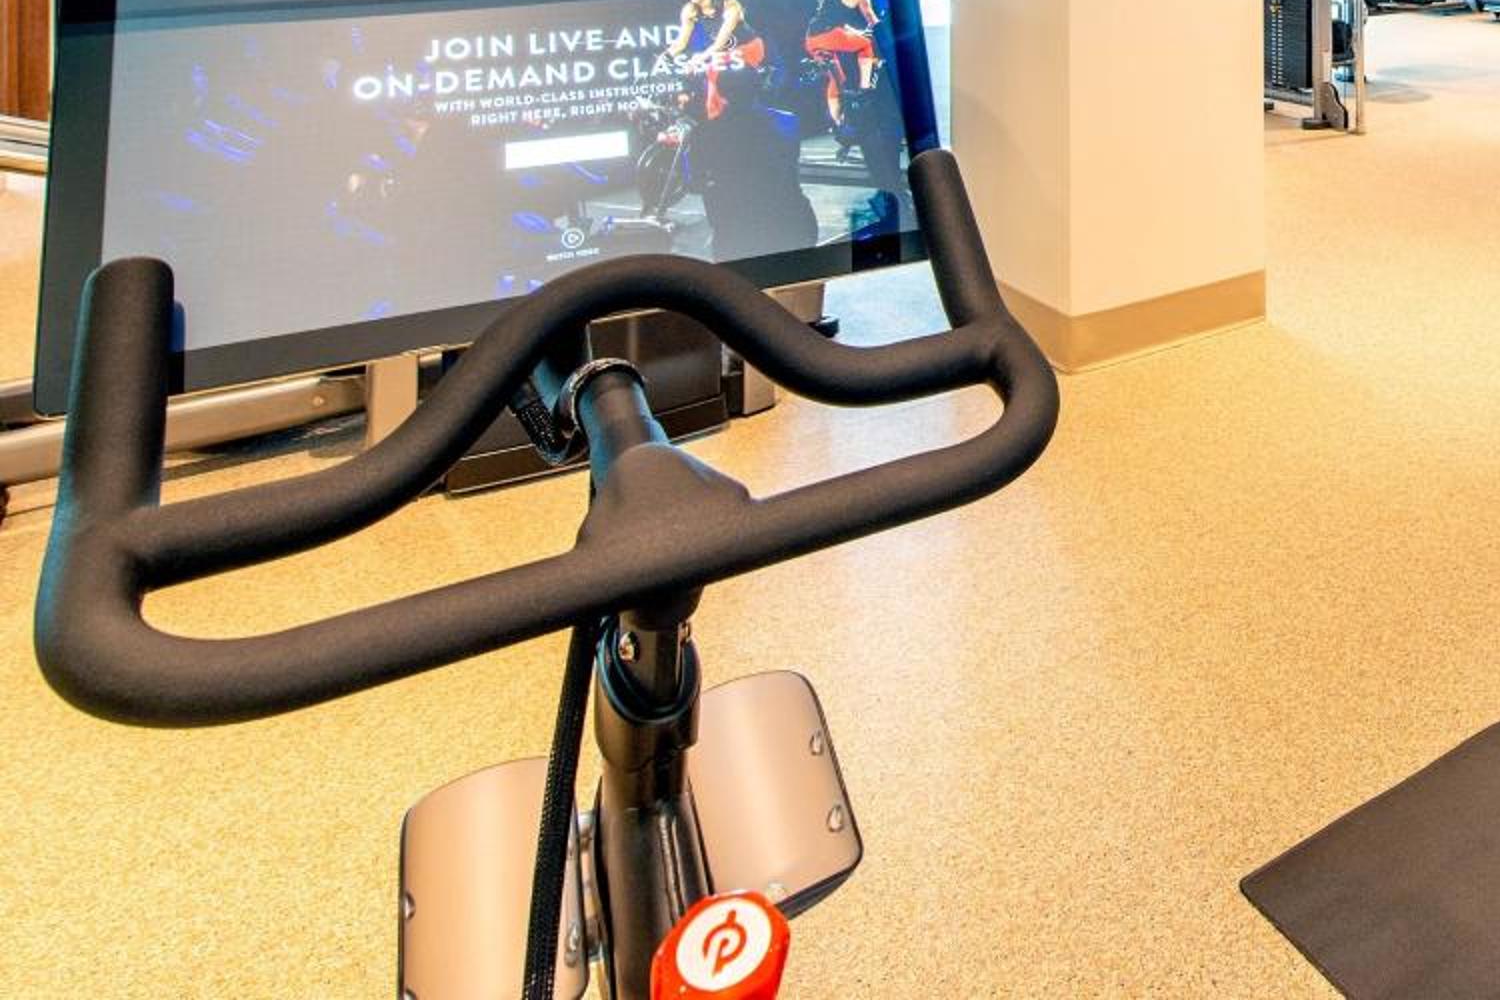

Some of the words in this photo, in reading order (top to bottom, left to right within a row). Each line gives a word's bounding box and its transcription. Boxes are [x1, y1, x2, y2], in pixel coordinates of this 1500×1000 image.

[425, 34, 513, 62] JOIN
[529, 29, 603, 55] LIVE
[615, 24, 683, 50] AND
[353, 60, 596, 100] ON-DEMAND
[608, 50, 746, 80] CLASSES
[435, 101, 475, 113] WITH
[479, 89, 584, 109] WORLD-CLASS
[589, 82, 684, 99] INSTRUCTORS
[471, 111, 518, 126] RIGHT
